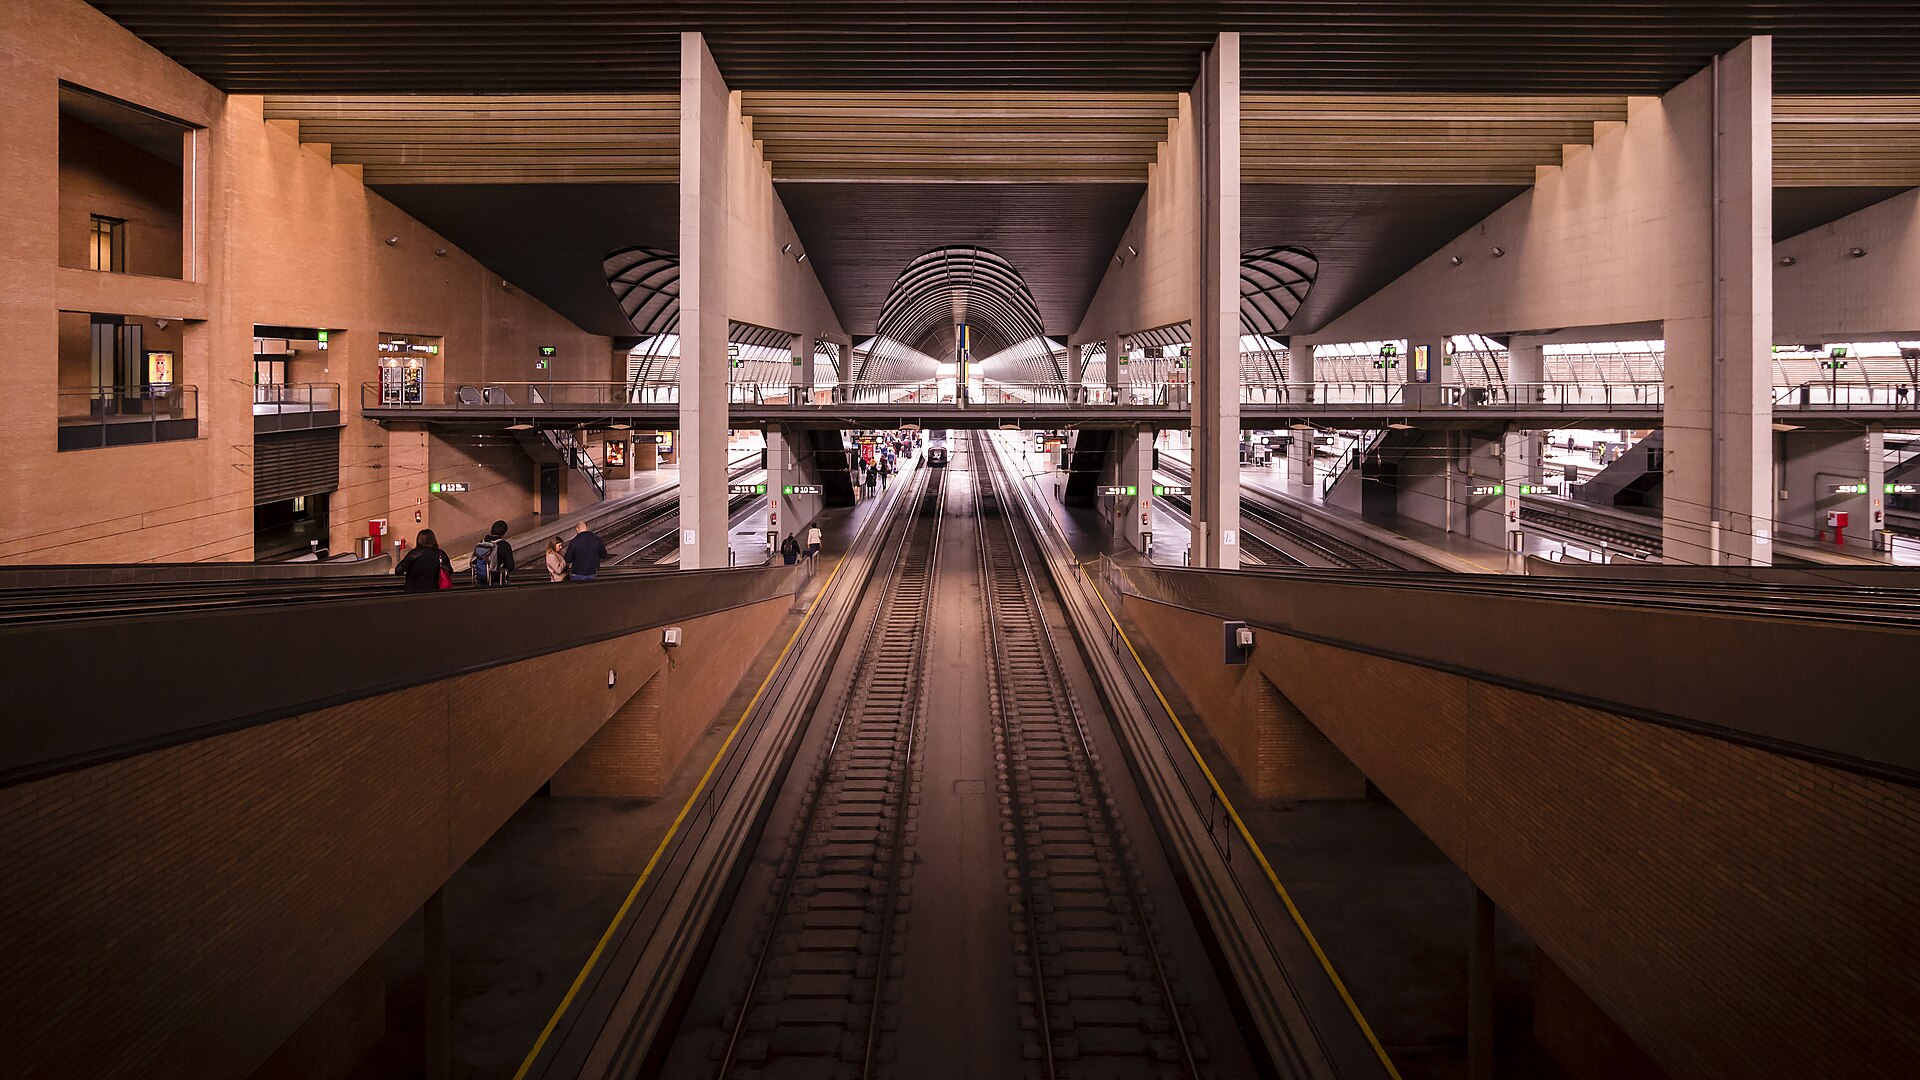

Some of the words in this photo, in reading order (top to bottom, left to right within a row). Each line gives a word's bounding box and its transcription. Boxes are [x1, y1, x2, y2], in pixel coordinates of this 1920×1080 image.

[446, 484, 456, 492] 12
[741, 486, 749, 494] 11
[800, 486, 809, 494] 10
